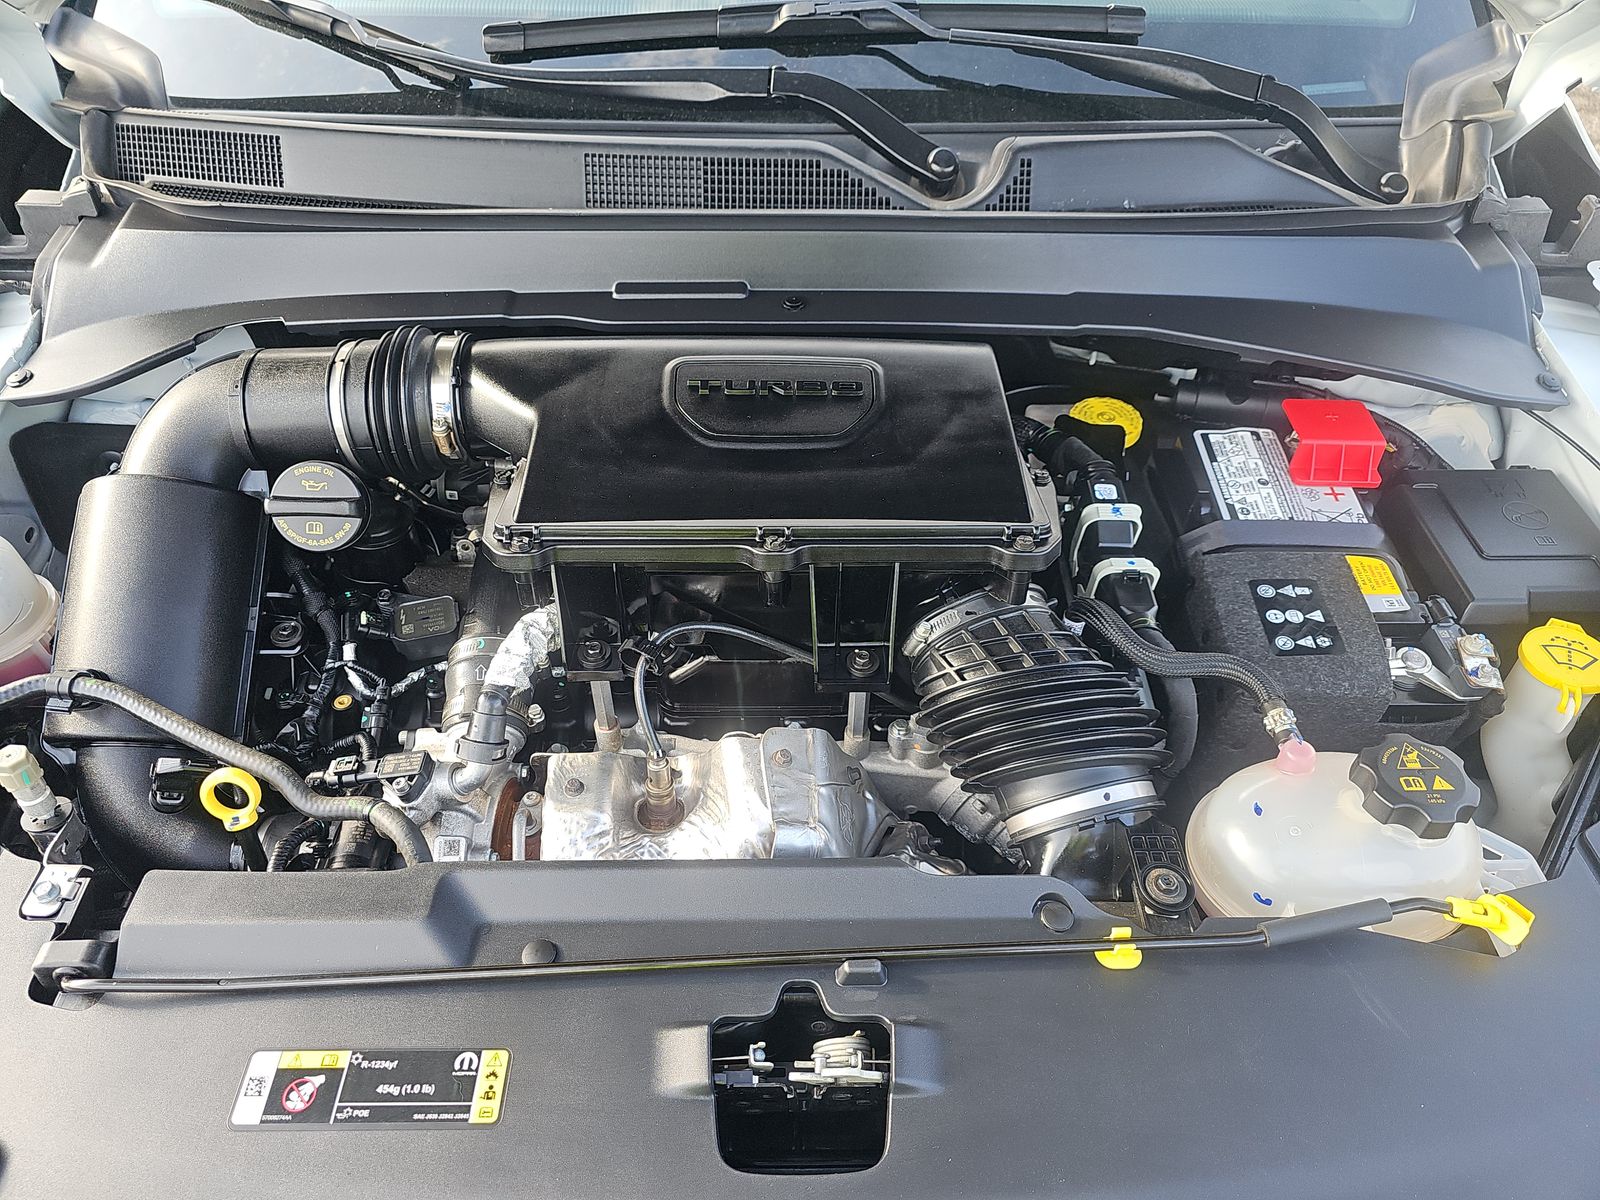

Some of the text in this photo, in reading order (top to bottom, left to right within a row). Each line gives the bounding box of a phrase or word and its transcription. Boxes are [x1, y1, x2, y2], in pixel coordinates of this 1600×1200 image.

[687, 379, 864, 397] TURBO
[293, 465, 336, 478] ENGINE OIL
[277, 518, 291, 532] API
[335, 522, 353, 540] 5W-30
[1355, 566, 1368, 586] BATTERY
[361, 1060, 399, 1071] R-1234yf
[375, 1084, 436, 1096] 454g (1.0 lb)
[353, 1109, 370, 1118] POE
